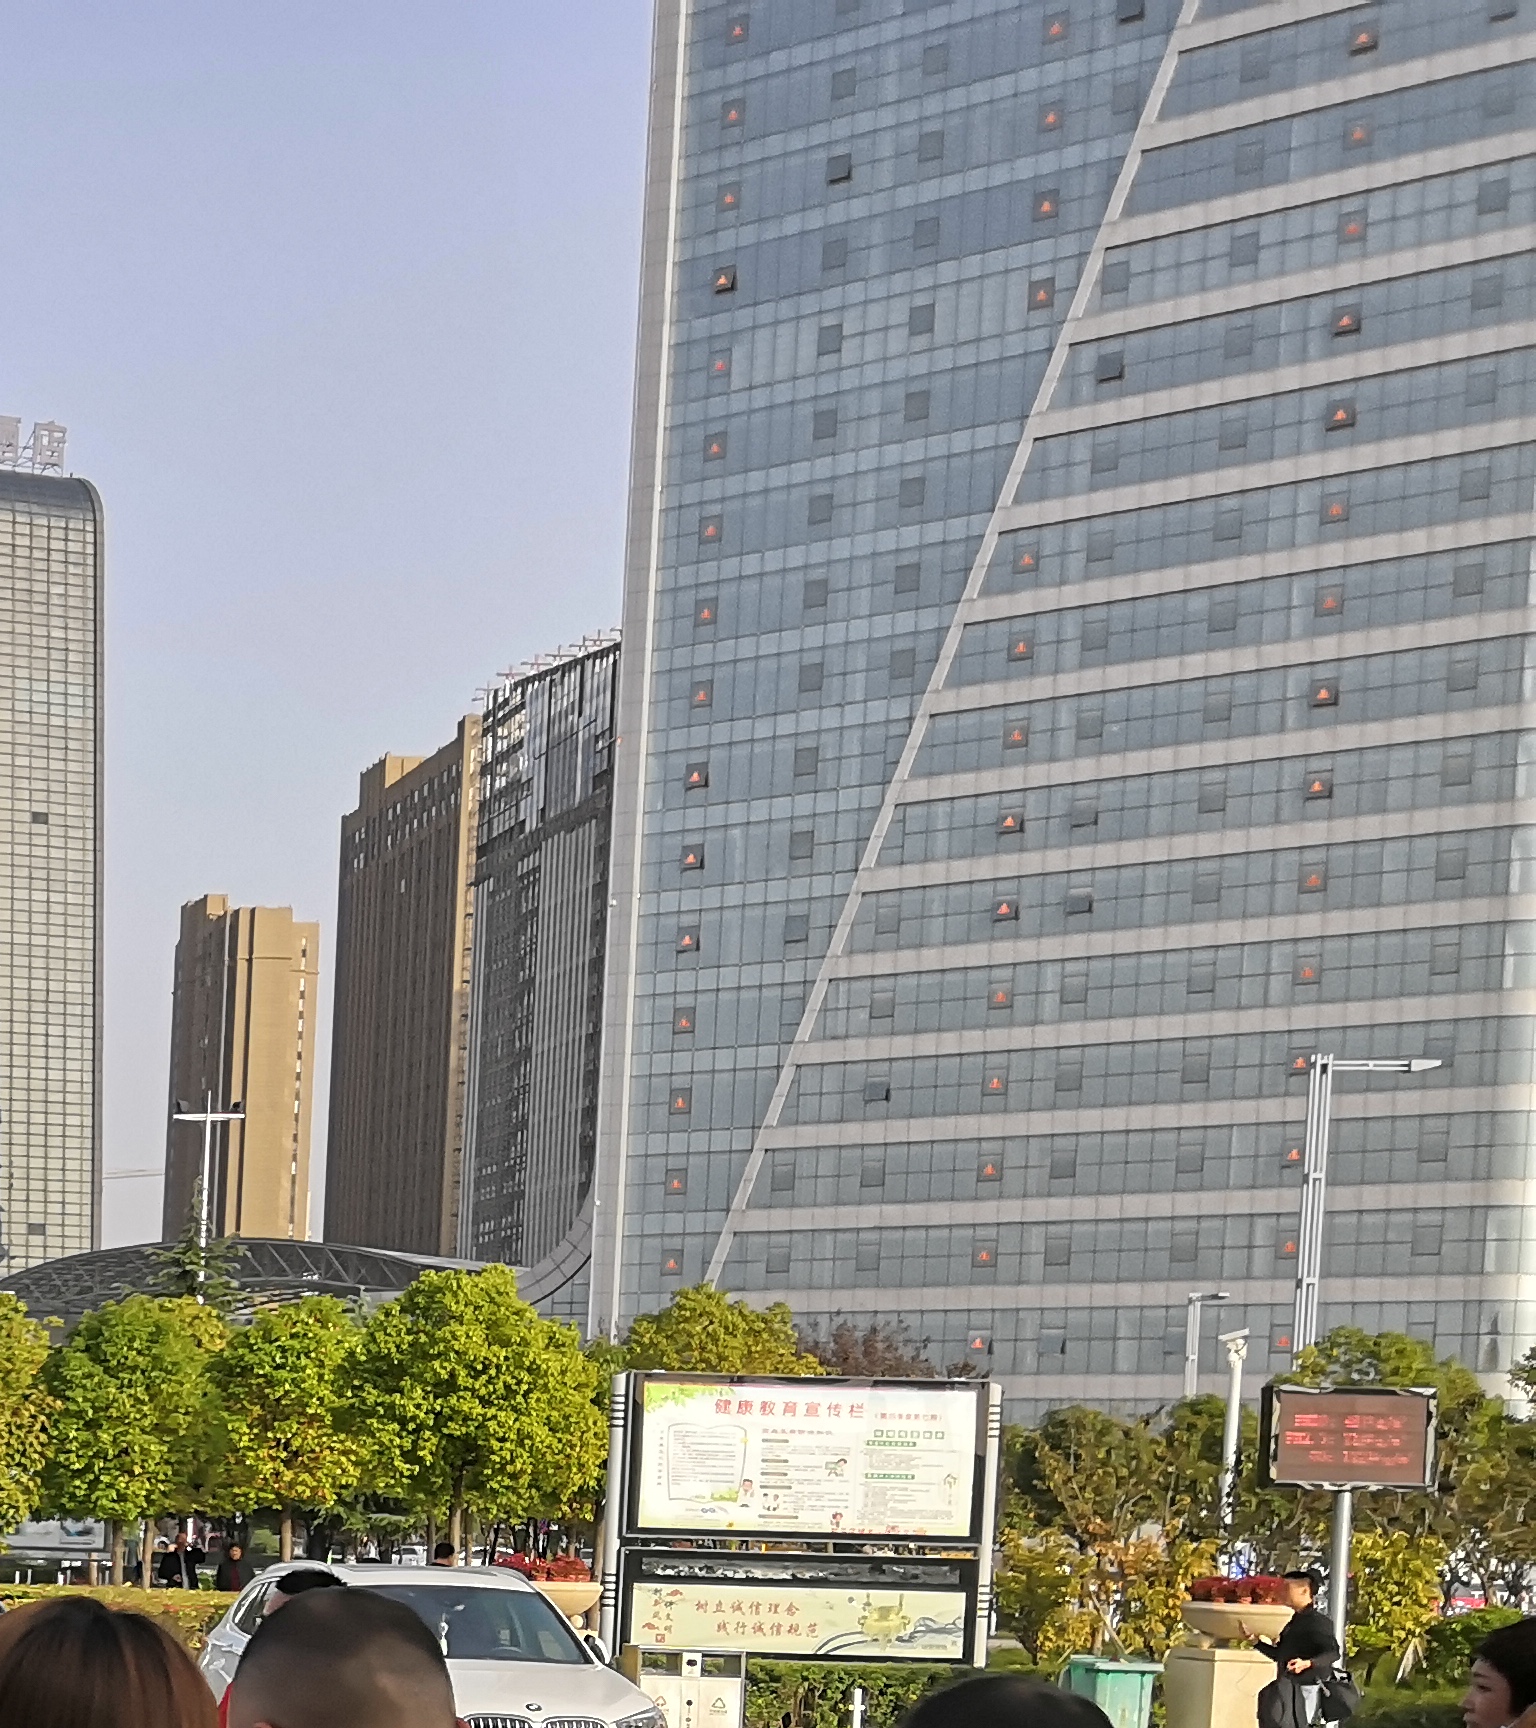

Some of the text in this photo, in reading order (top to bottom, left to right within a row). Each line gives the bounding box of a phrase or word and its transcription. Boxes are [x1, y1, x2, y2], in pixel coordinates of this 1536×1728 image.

[714, 1398, 864, 1419] 健康教育宣传栏
[694, 1599, 800, 1617] 树立诚信理念
